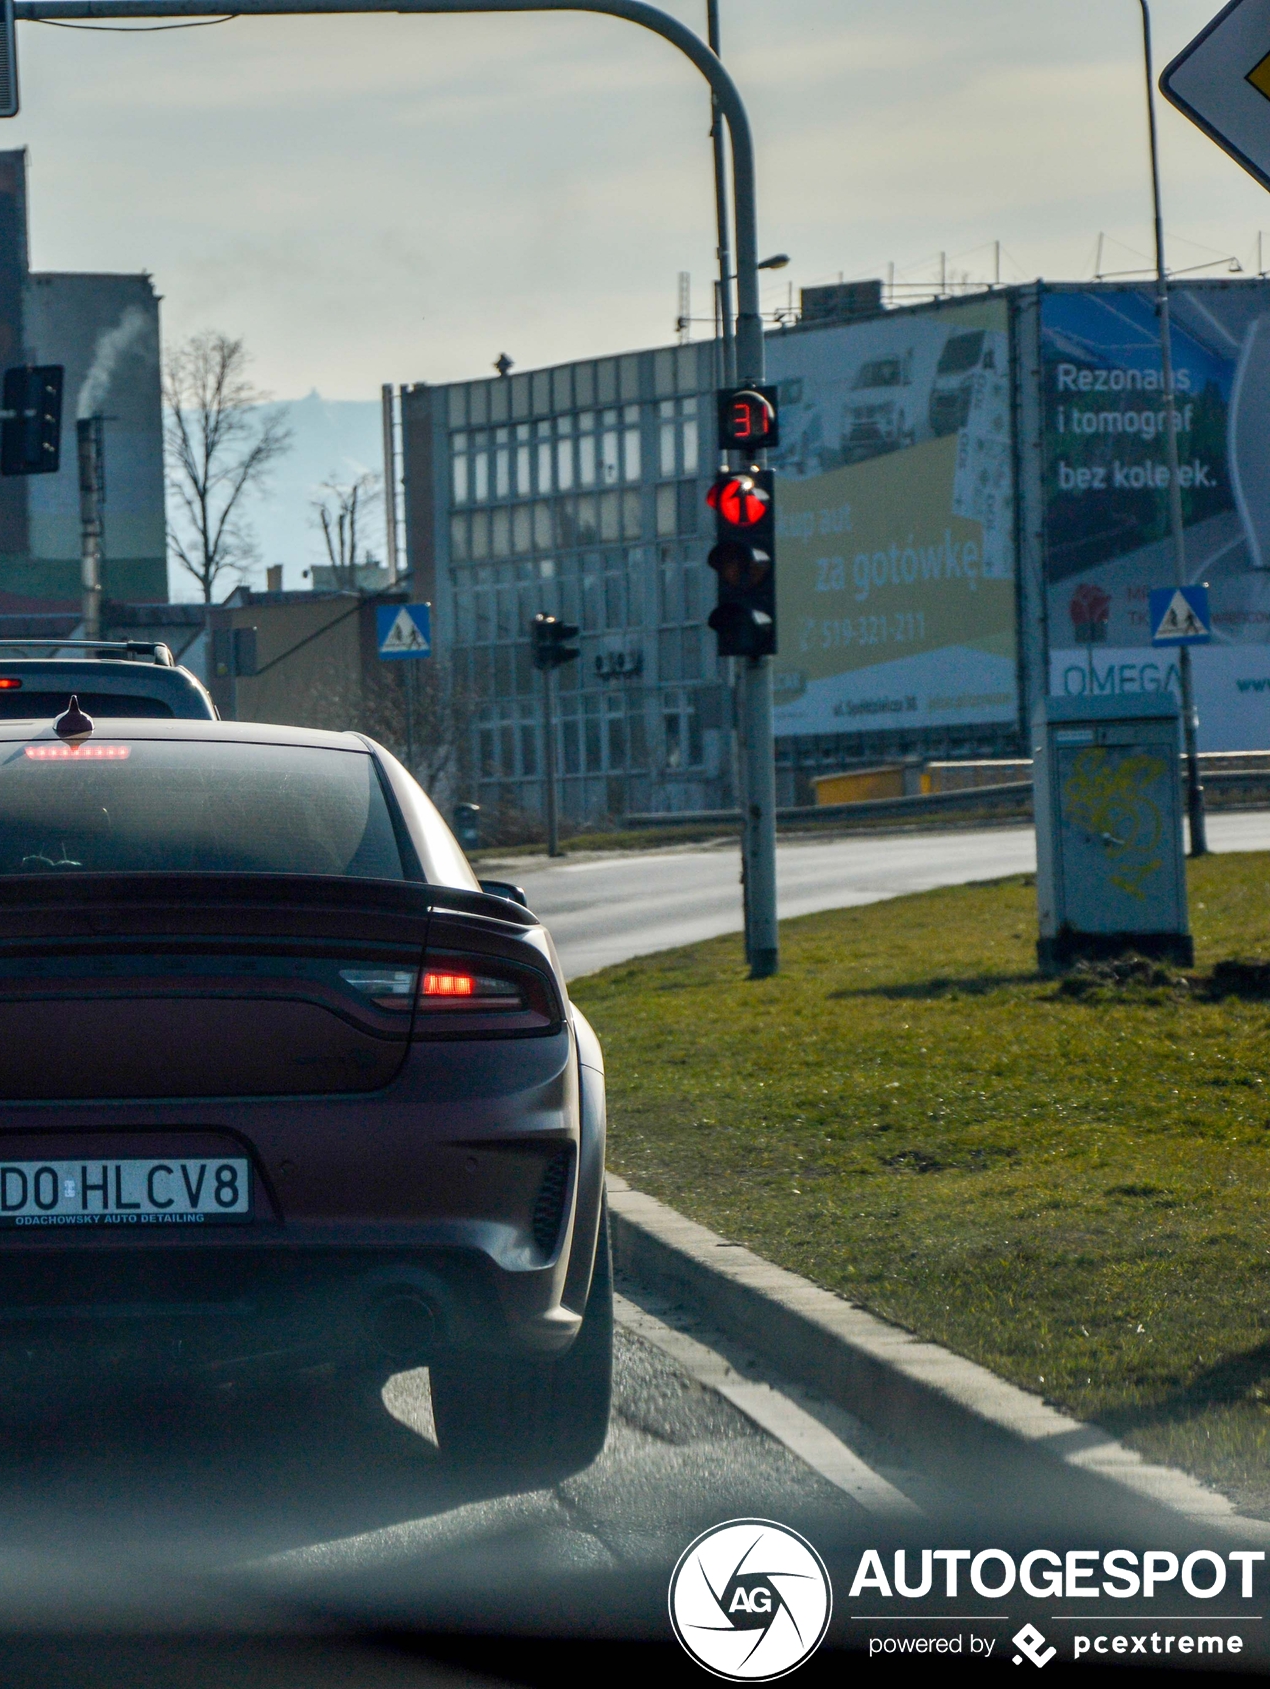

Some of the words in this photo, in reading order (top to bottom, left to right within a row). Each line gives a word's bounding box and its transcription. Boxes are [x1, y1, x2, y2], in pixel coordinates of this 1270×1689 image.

[734, 403, 769, 437] 31
[1058, 405, 1066, 433] i
[1060, 460, 1107, 490] bez
[1114, 458, 1217, 488] koleek.
[815, 555, 845, 592] za
[853, 528, 979, 601] gotówkę
[81, 1164, 240, 1211] HLCV8
[15, 1215, 101, 1226] ODACHOWSKY
[104, 1214, 138, 1224] AUTO
[141, 1213, 205, 1224] DETAILING
